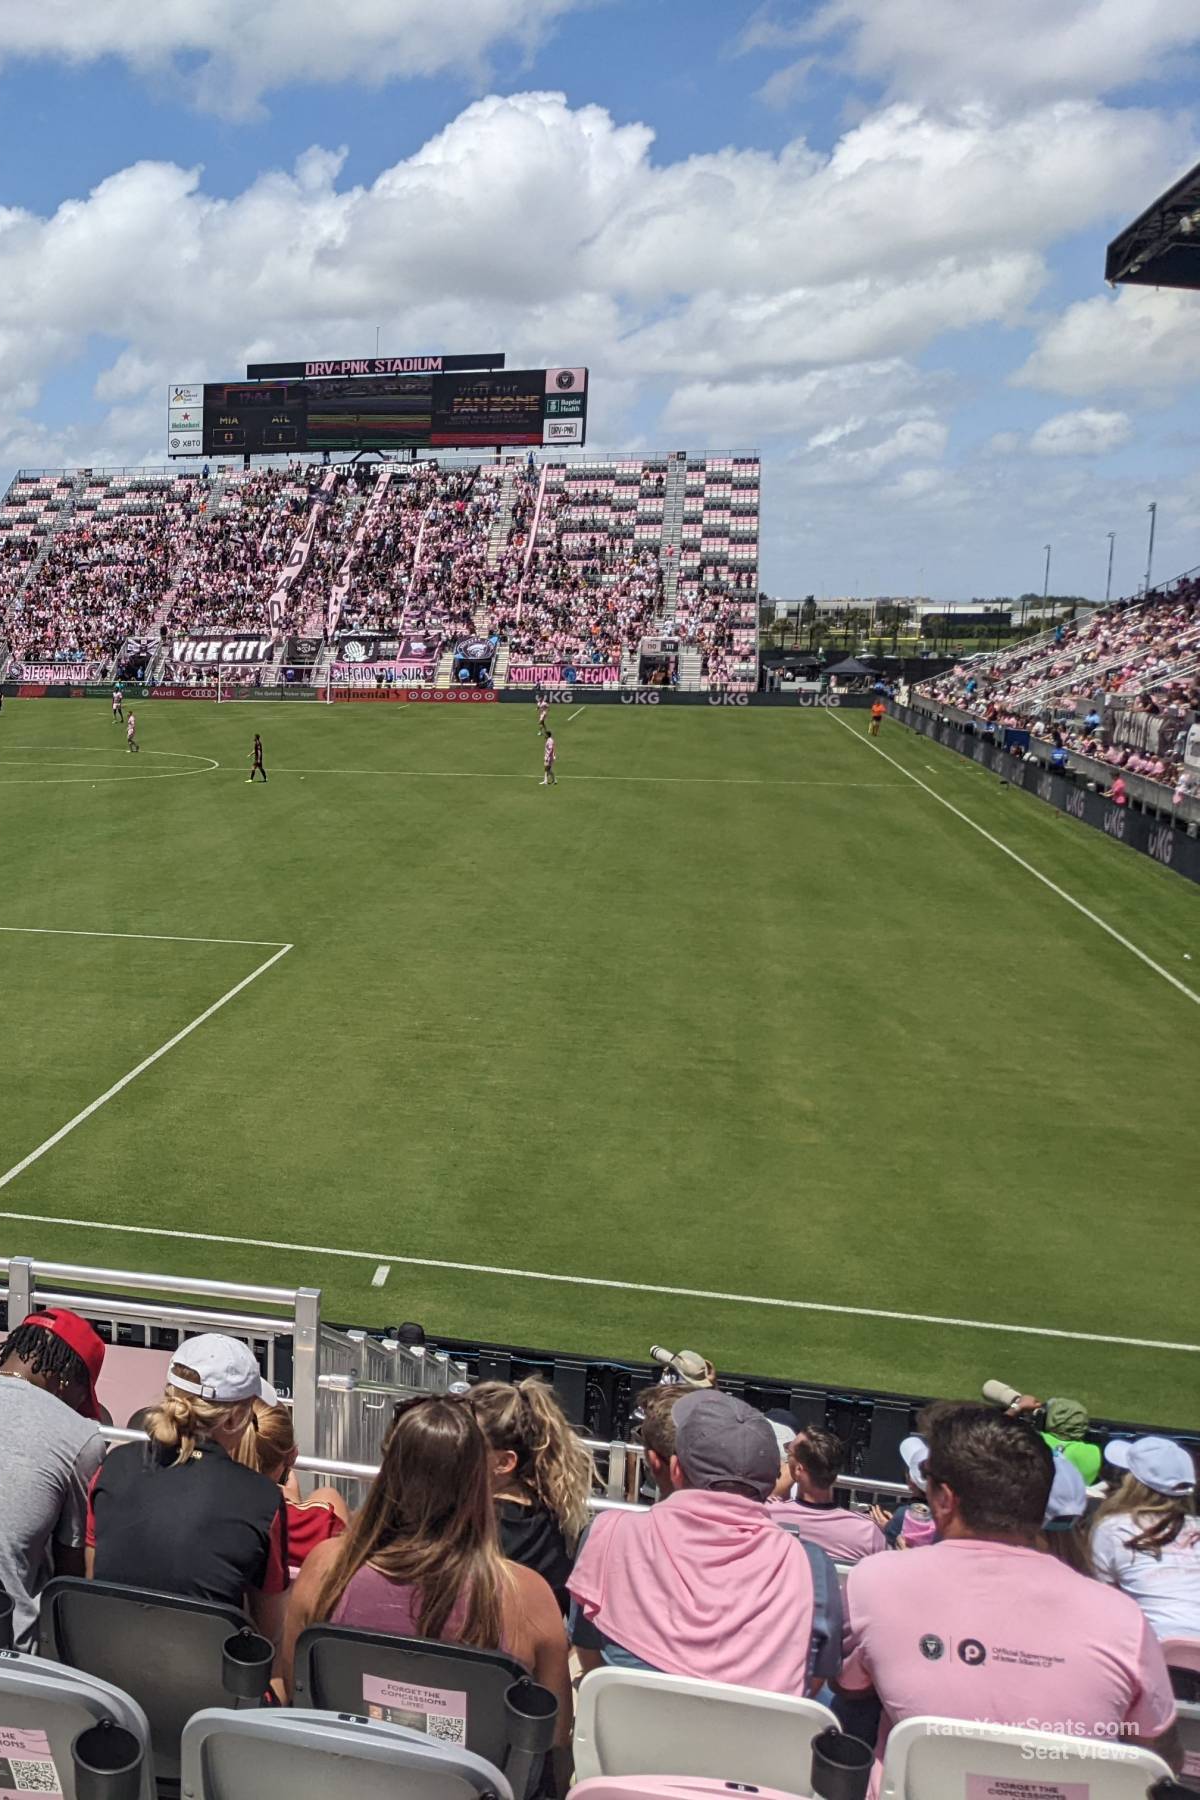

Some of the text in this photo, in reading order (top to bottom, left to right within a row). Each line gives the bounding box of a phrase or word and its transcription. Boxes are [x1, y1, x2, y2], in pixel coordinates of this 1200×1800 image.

[374, 357, 443, 373] STADIUM
[560, 398, 581, 407] Baptist
[219, 416, 239, 425] MIA
[182, 439, 201, 447] XBTO
[333, 462, 358, 476] CITY
[369, 461, 430, 476] PRESENTE
[173, 641, 222, 663] VICE
[222, 640, 274, 662] CITY
[23, 664, 87, 680] SIEGE MIAMI
[401, 668, 423, 681] SUR
[509, 666, 619, 684] SOUTHERN EGION
[152, 689, 176, 697] Audi
[535, 691, 573, 704] UKG
[621, 691, 660, 704] UKG
[708, 692, 749, 706] UKG
[800, 694, 841, 707] UKG
[1066, 790, 1085, 818] UKG
[1104, 808, 1126, 838] UKG
[1148, 827, 1175, 864] UKG
[381, 1689, 447, 1706] CONCESSIONS
[387, 1683, 441, 1699] FORGET THE
[994, 1781, 1059, 1793] FORGET THE
